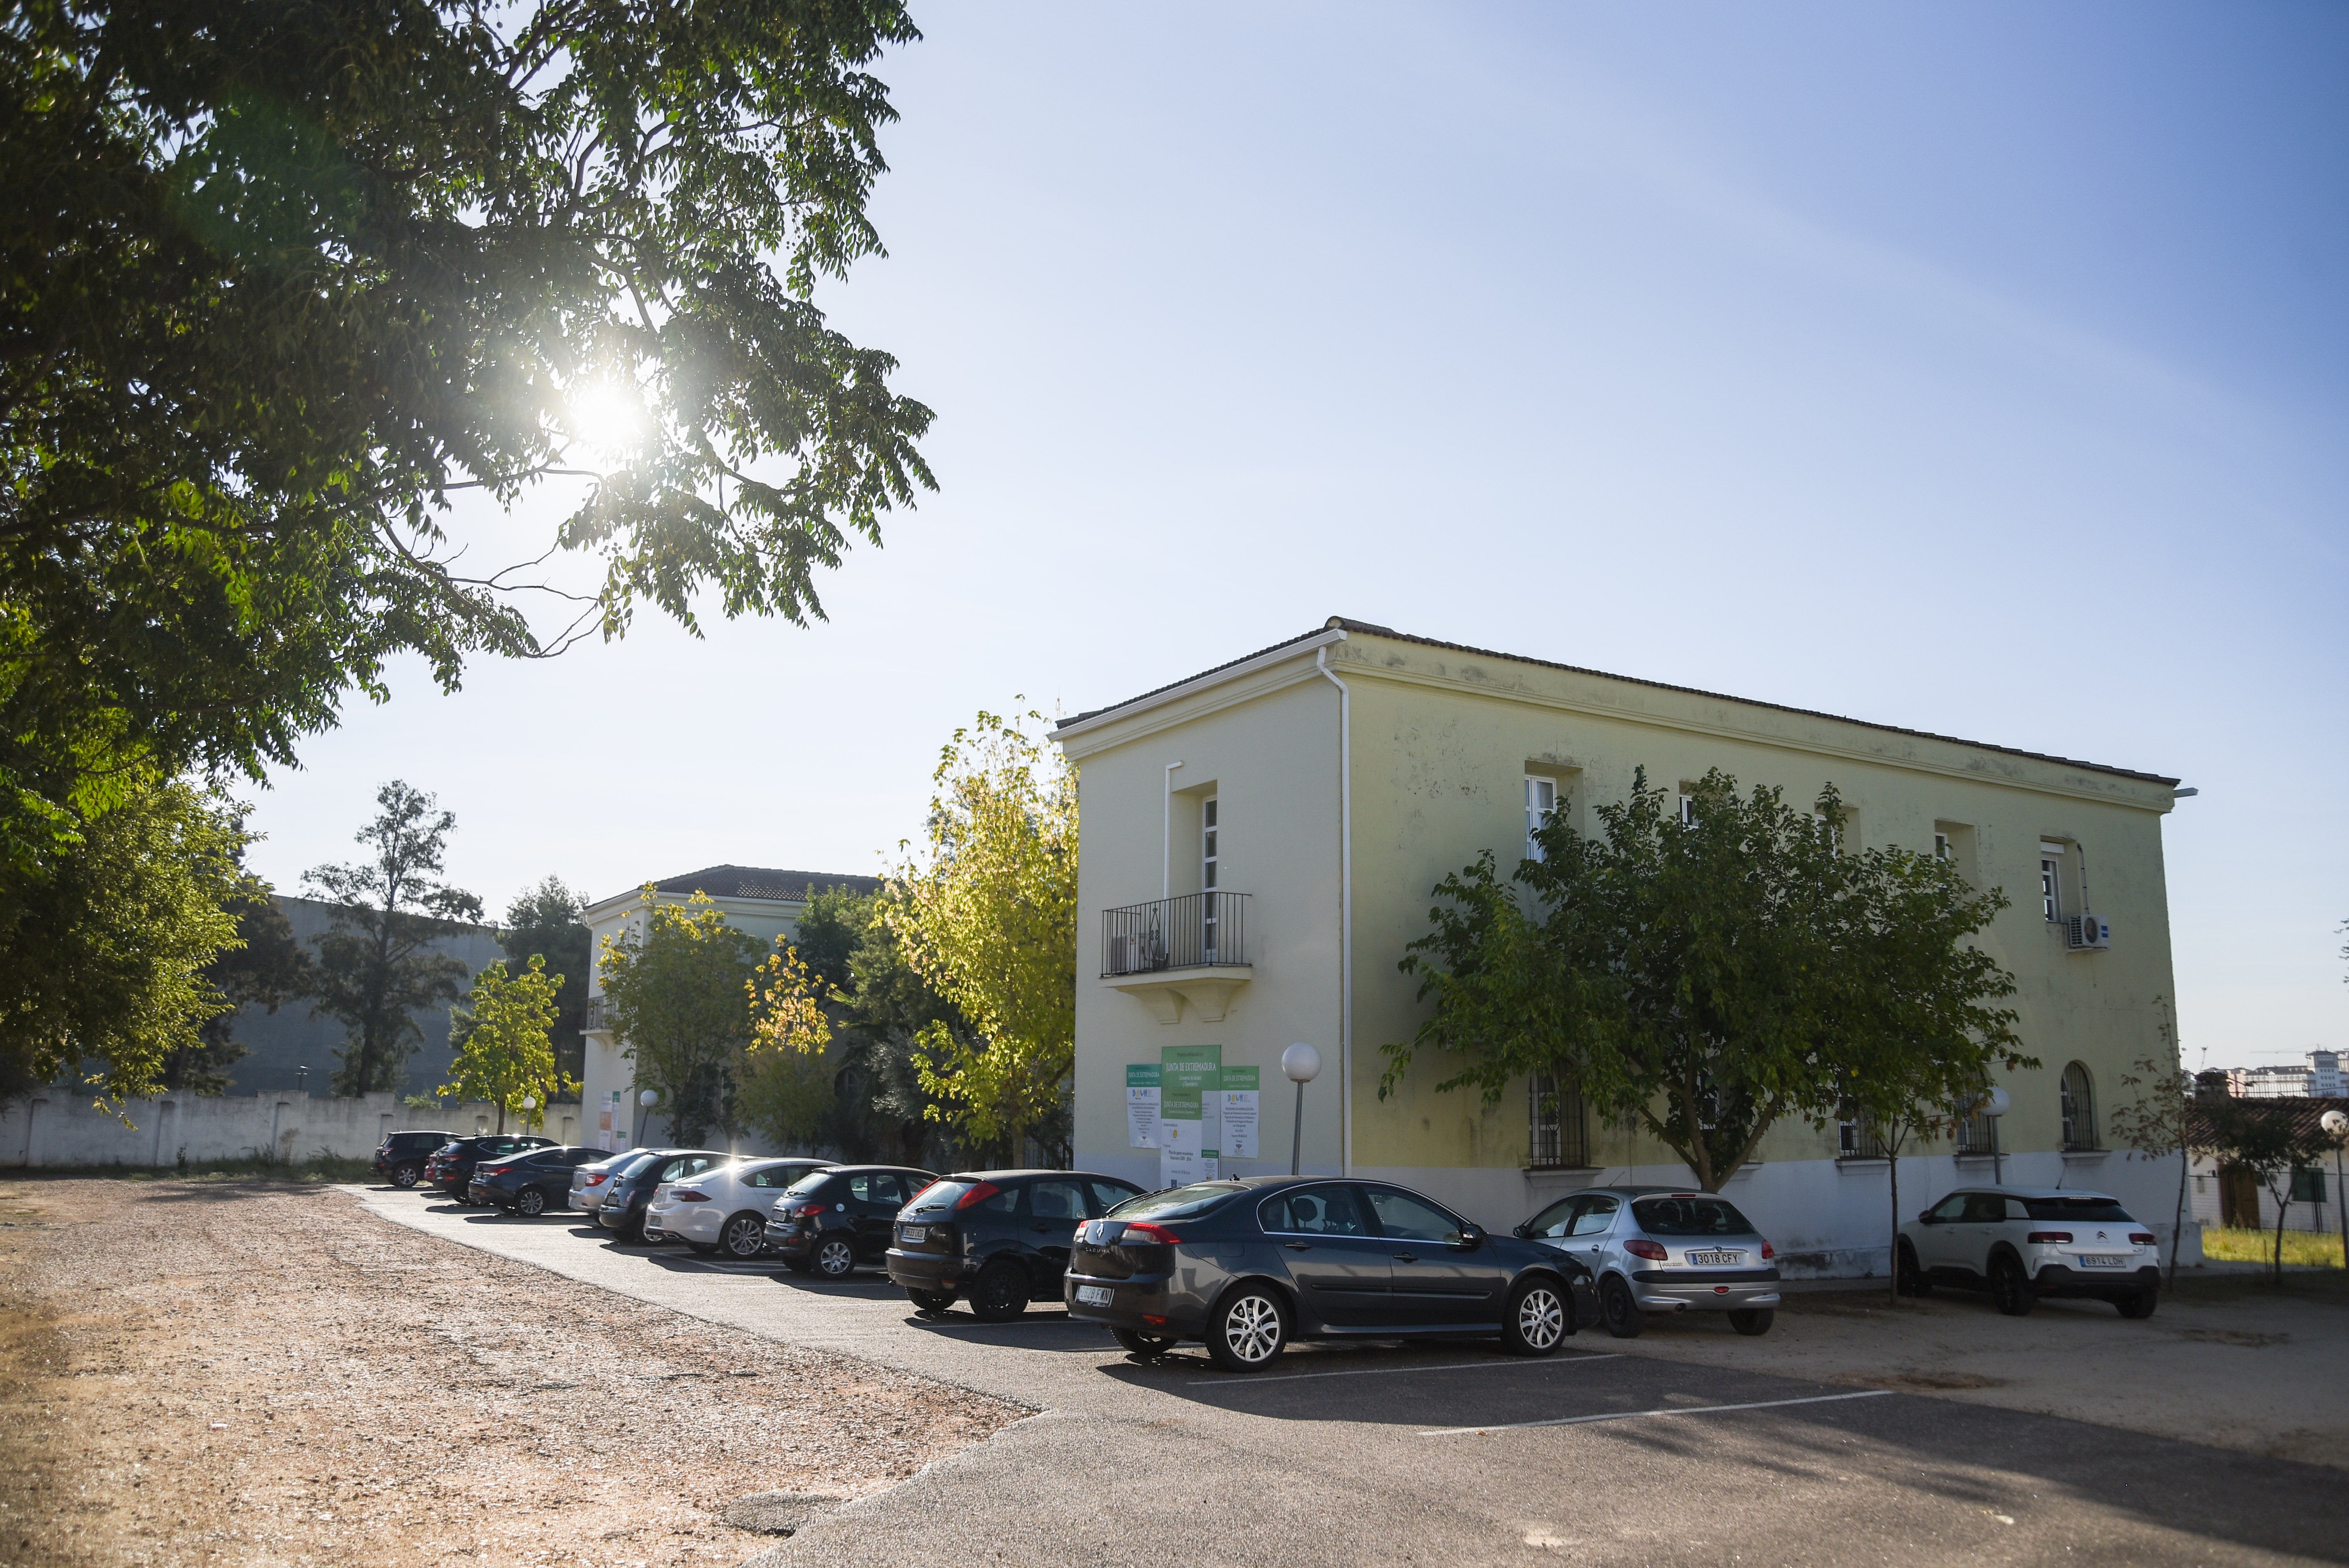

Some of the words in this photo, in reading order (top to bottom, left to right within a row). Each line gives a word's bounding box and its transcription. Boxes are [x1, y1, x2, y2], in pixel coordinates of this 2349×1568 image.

[1166, 1063, 1179, 1073] JUNTA
[1180, 1063, 1185, 1071] DE
[1185, 1062, 1216, 1071] EXTREMADURA
[1698, 1254, 1720, 1263] 3018
[1722, 1254, 1737, 1263] CFY
[2108, 1257, 2124, 1265] LDH
[1081, 1288, 1095, 1299] 2628
